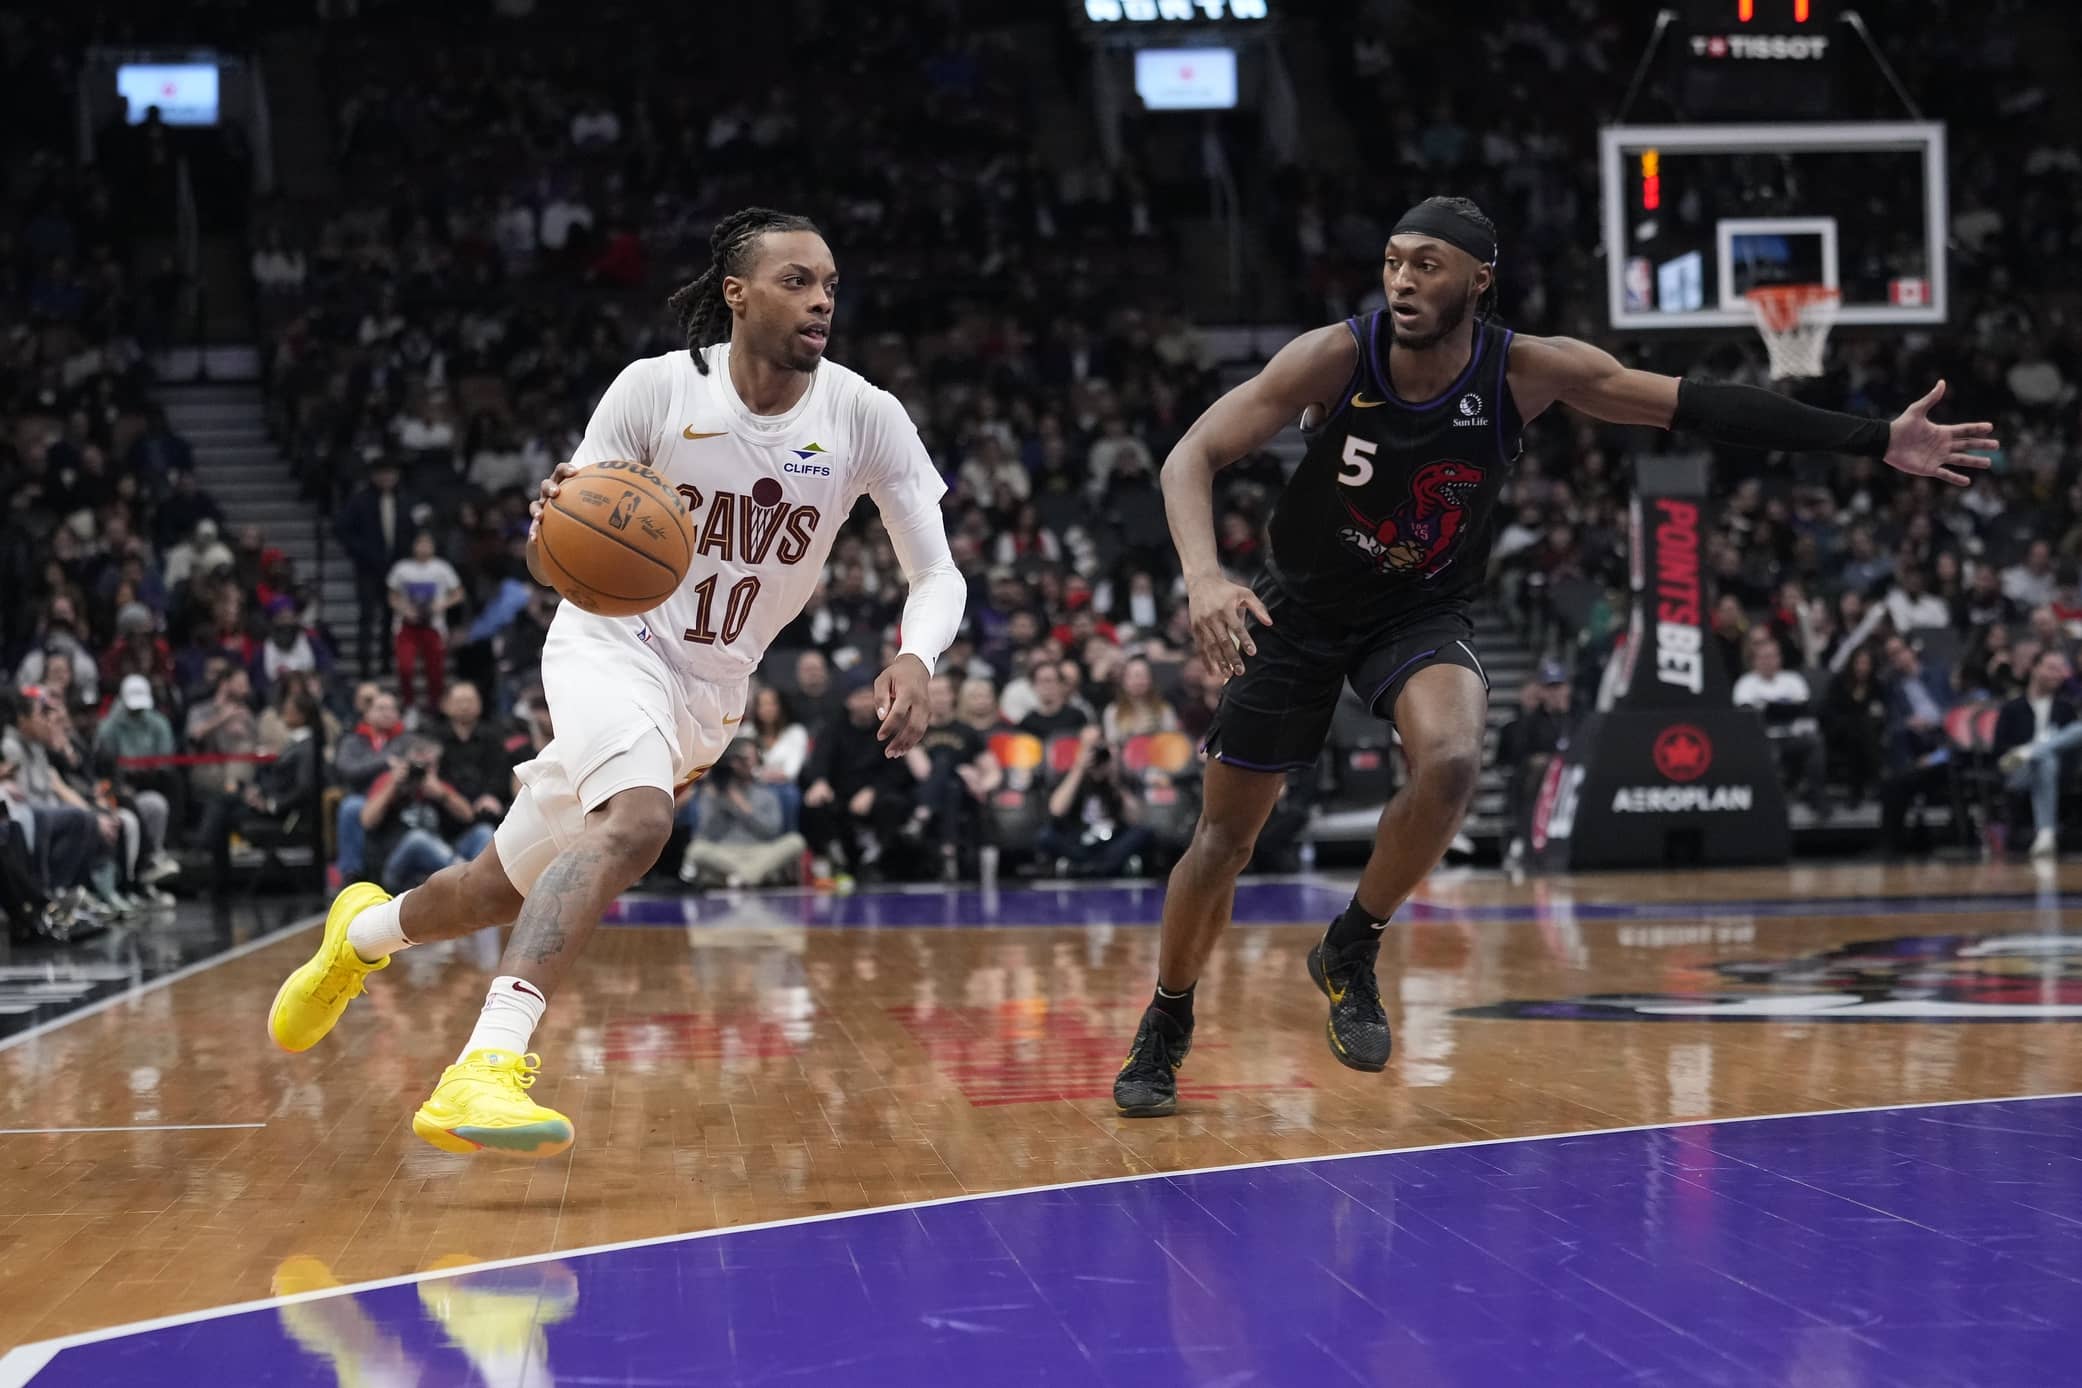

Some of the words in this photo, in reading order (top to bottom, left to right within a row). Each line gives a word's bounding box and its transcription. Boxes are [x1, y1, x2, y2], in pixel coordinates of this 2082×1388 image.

[1453, 418, 1470, 427] Sun
[1471, 417, 1488, 427] Life
[784, 462, 831, 477] CLIFFS
[1337, 434, 1378, 487] 5
[683, 572, 762, 646] 10
[1656, 497, 1703, 694] POINTSBET
[1612, 785, 1754, 813] AEROPLAN
